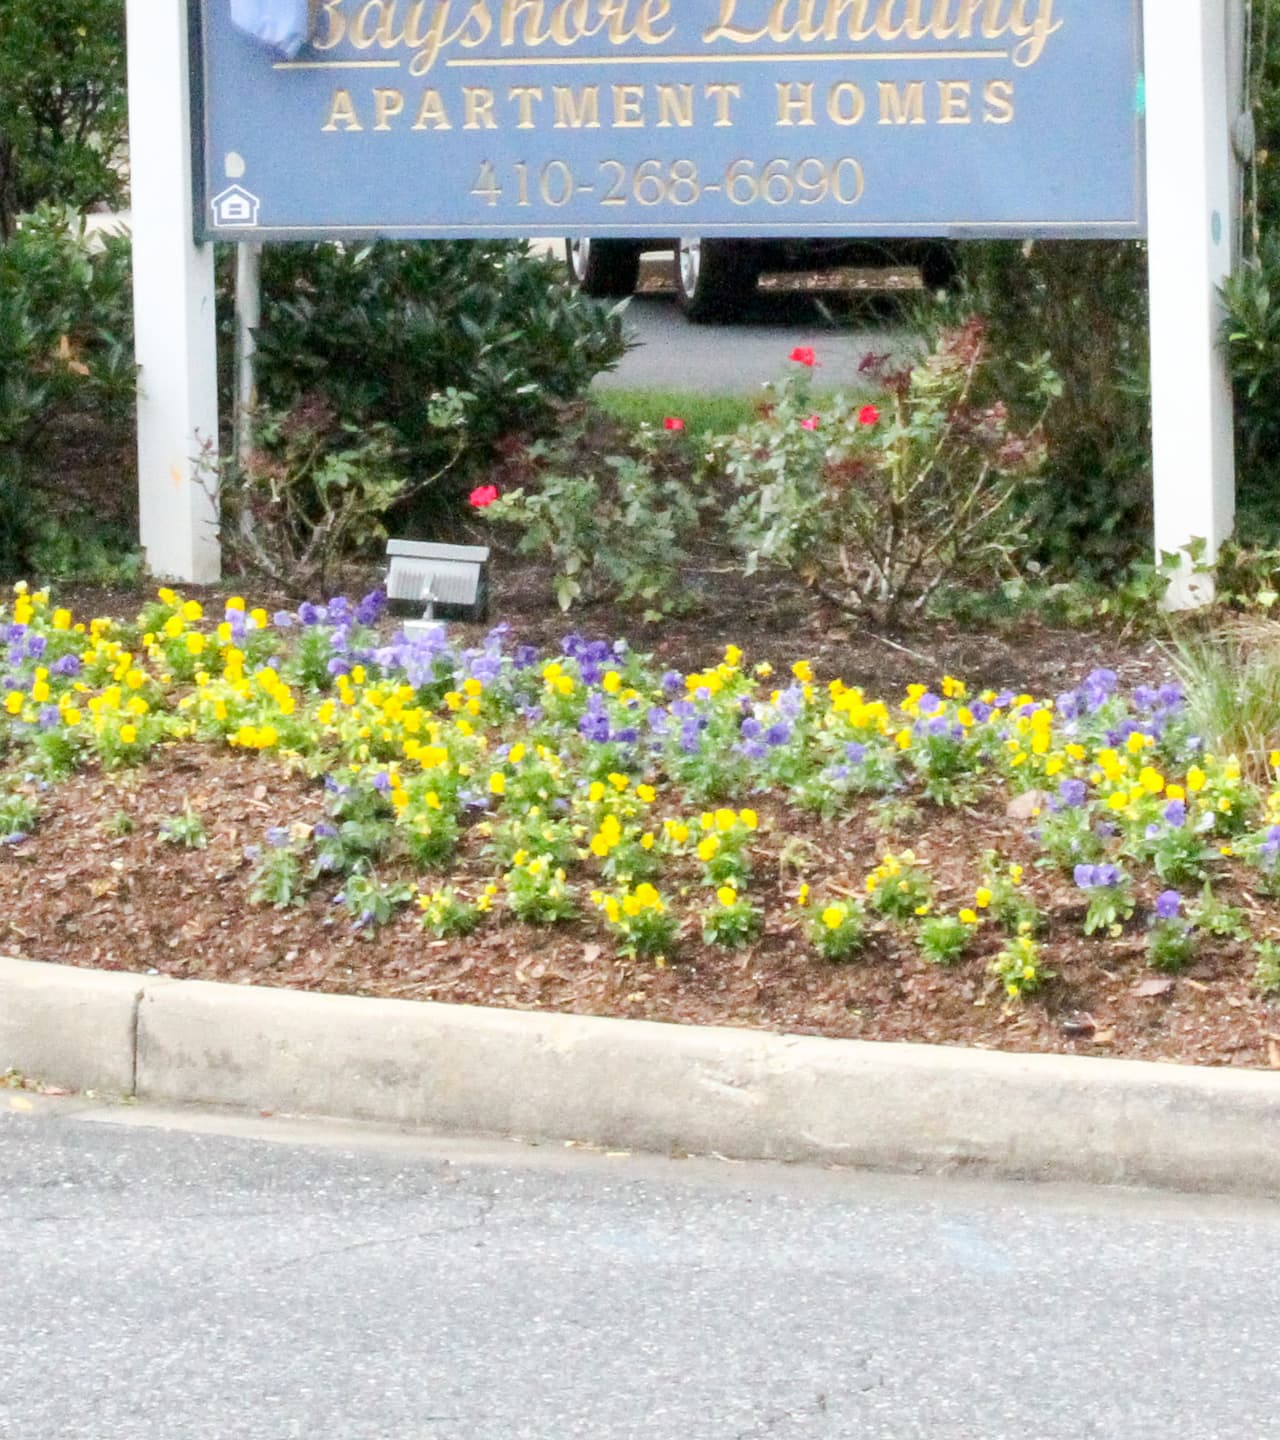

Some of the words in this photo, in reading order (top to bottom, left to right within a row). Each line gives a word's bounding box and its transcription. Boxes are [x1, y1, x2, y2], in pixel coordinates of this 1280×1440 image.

[320, 81, 742, 132] APARTMENT
[774, 79, 1015, 127] HOMES
[470, 155, 866, 208] 410-268-6690
